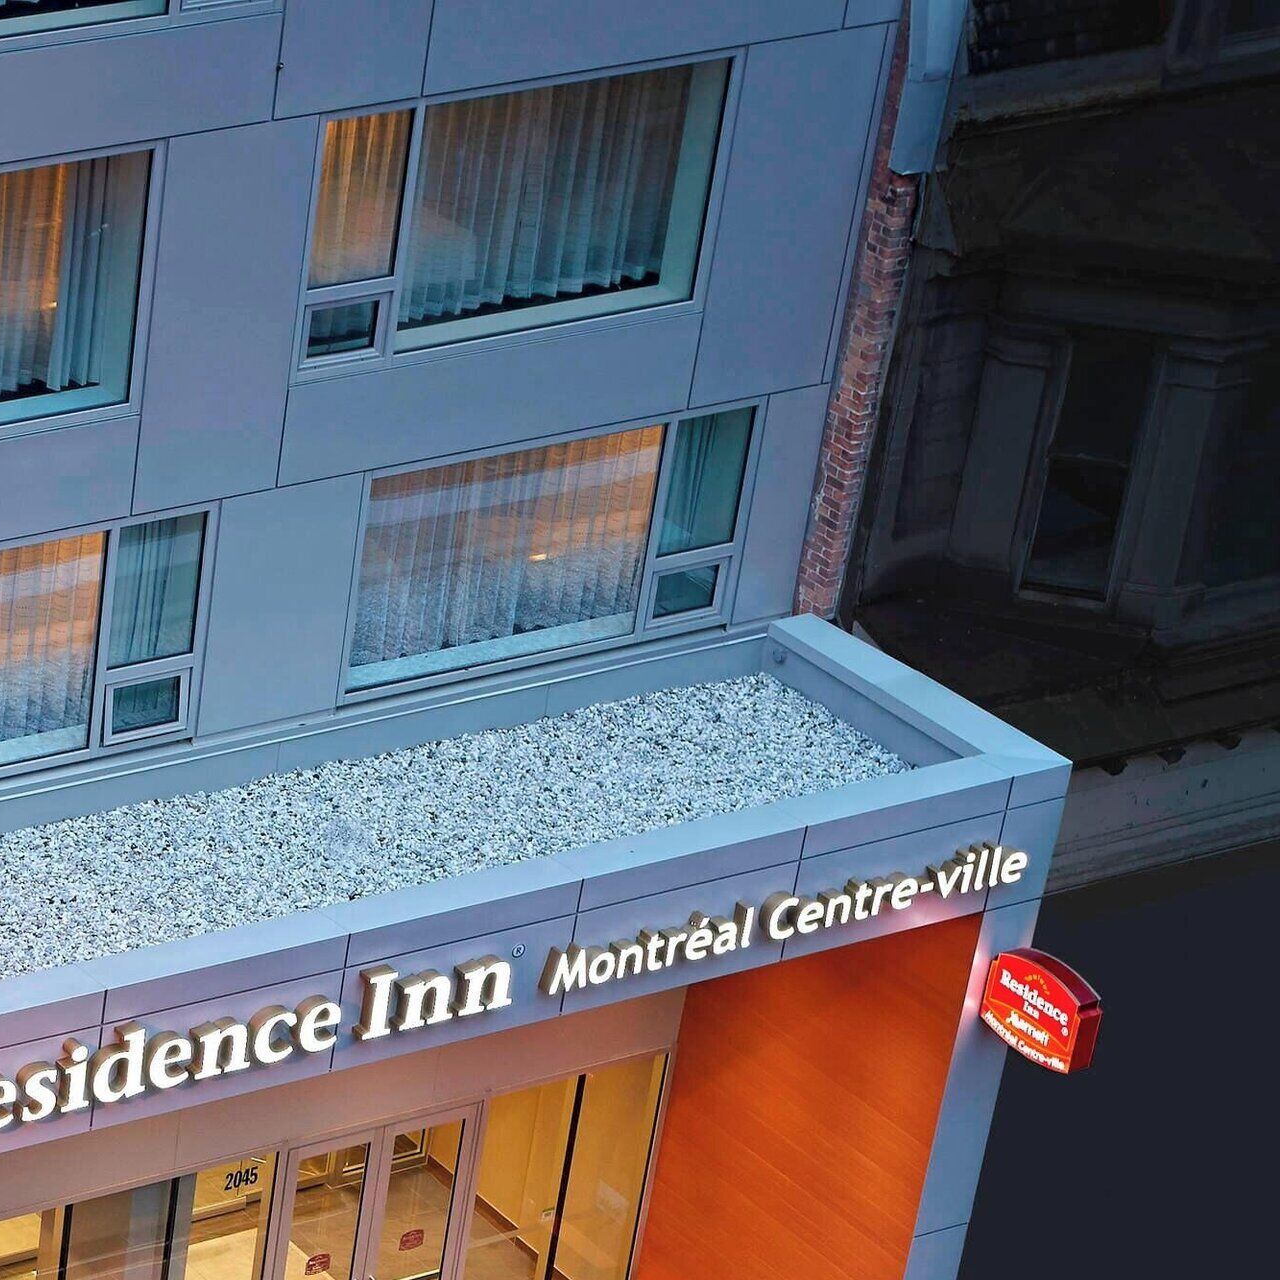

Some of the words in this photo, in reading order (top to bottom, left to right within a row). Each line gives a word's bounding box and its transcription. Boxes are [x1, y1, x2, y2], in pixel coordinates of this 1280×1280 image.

[543, 906, 755, 996] Montréal
[765, 844, 1029, 942] Centre-ville
[355, 958, 513, 1040] Inn
[999, 968, 1069, 1026] Residence
[224, 1165, 259, 1191] 2045
